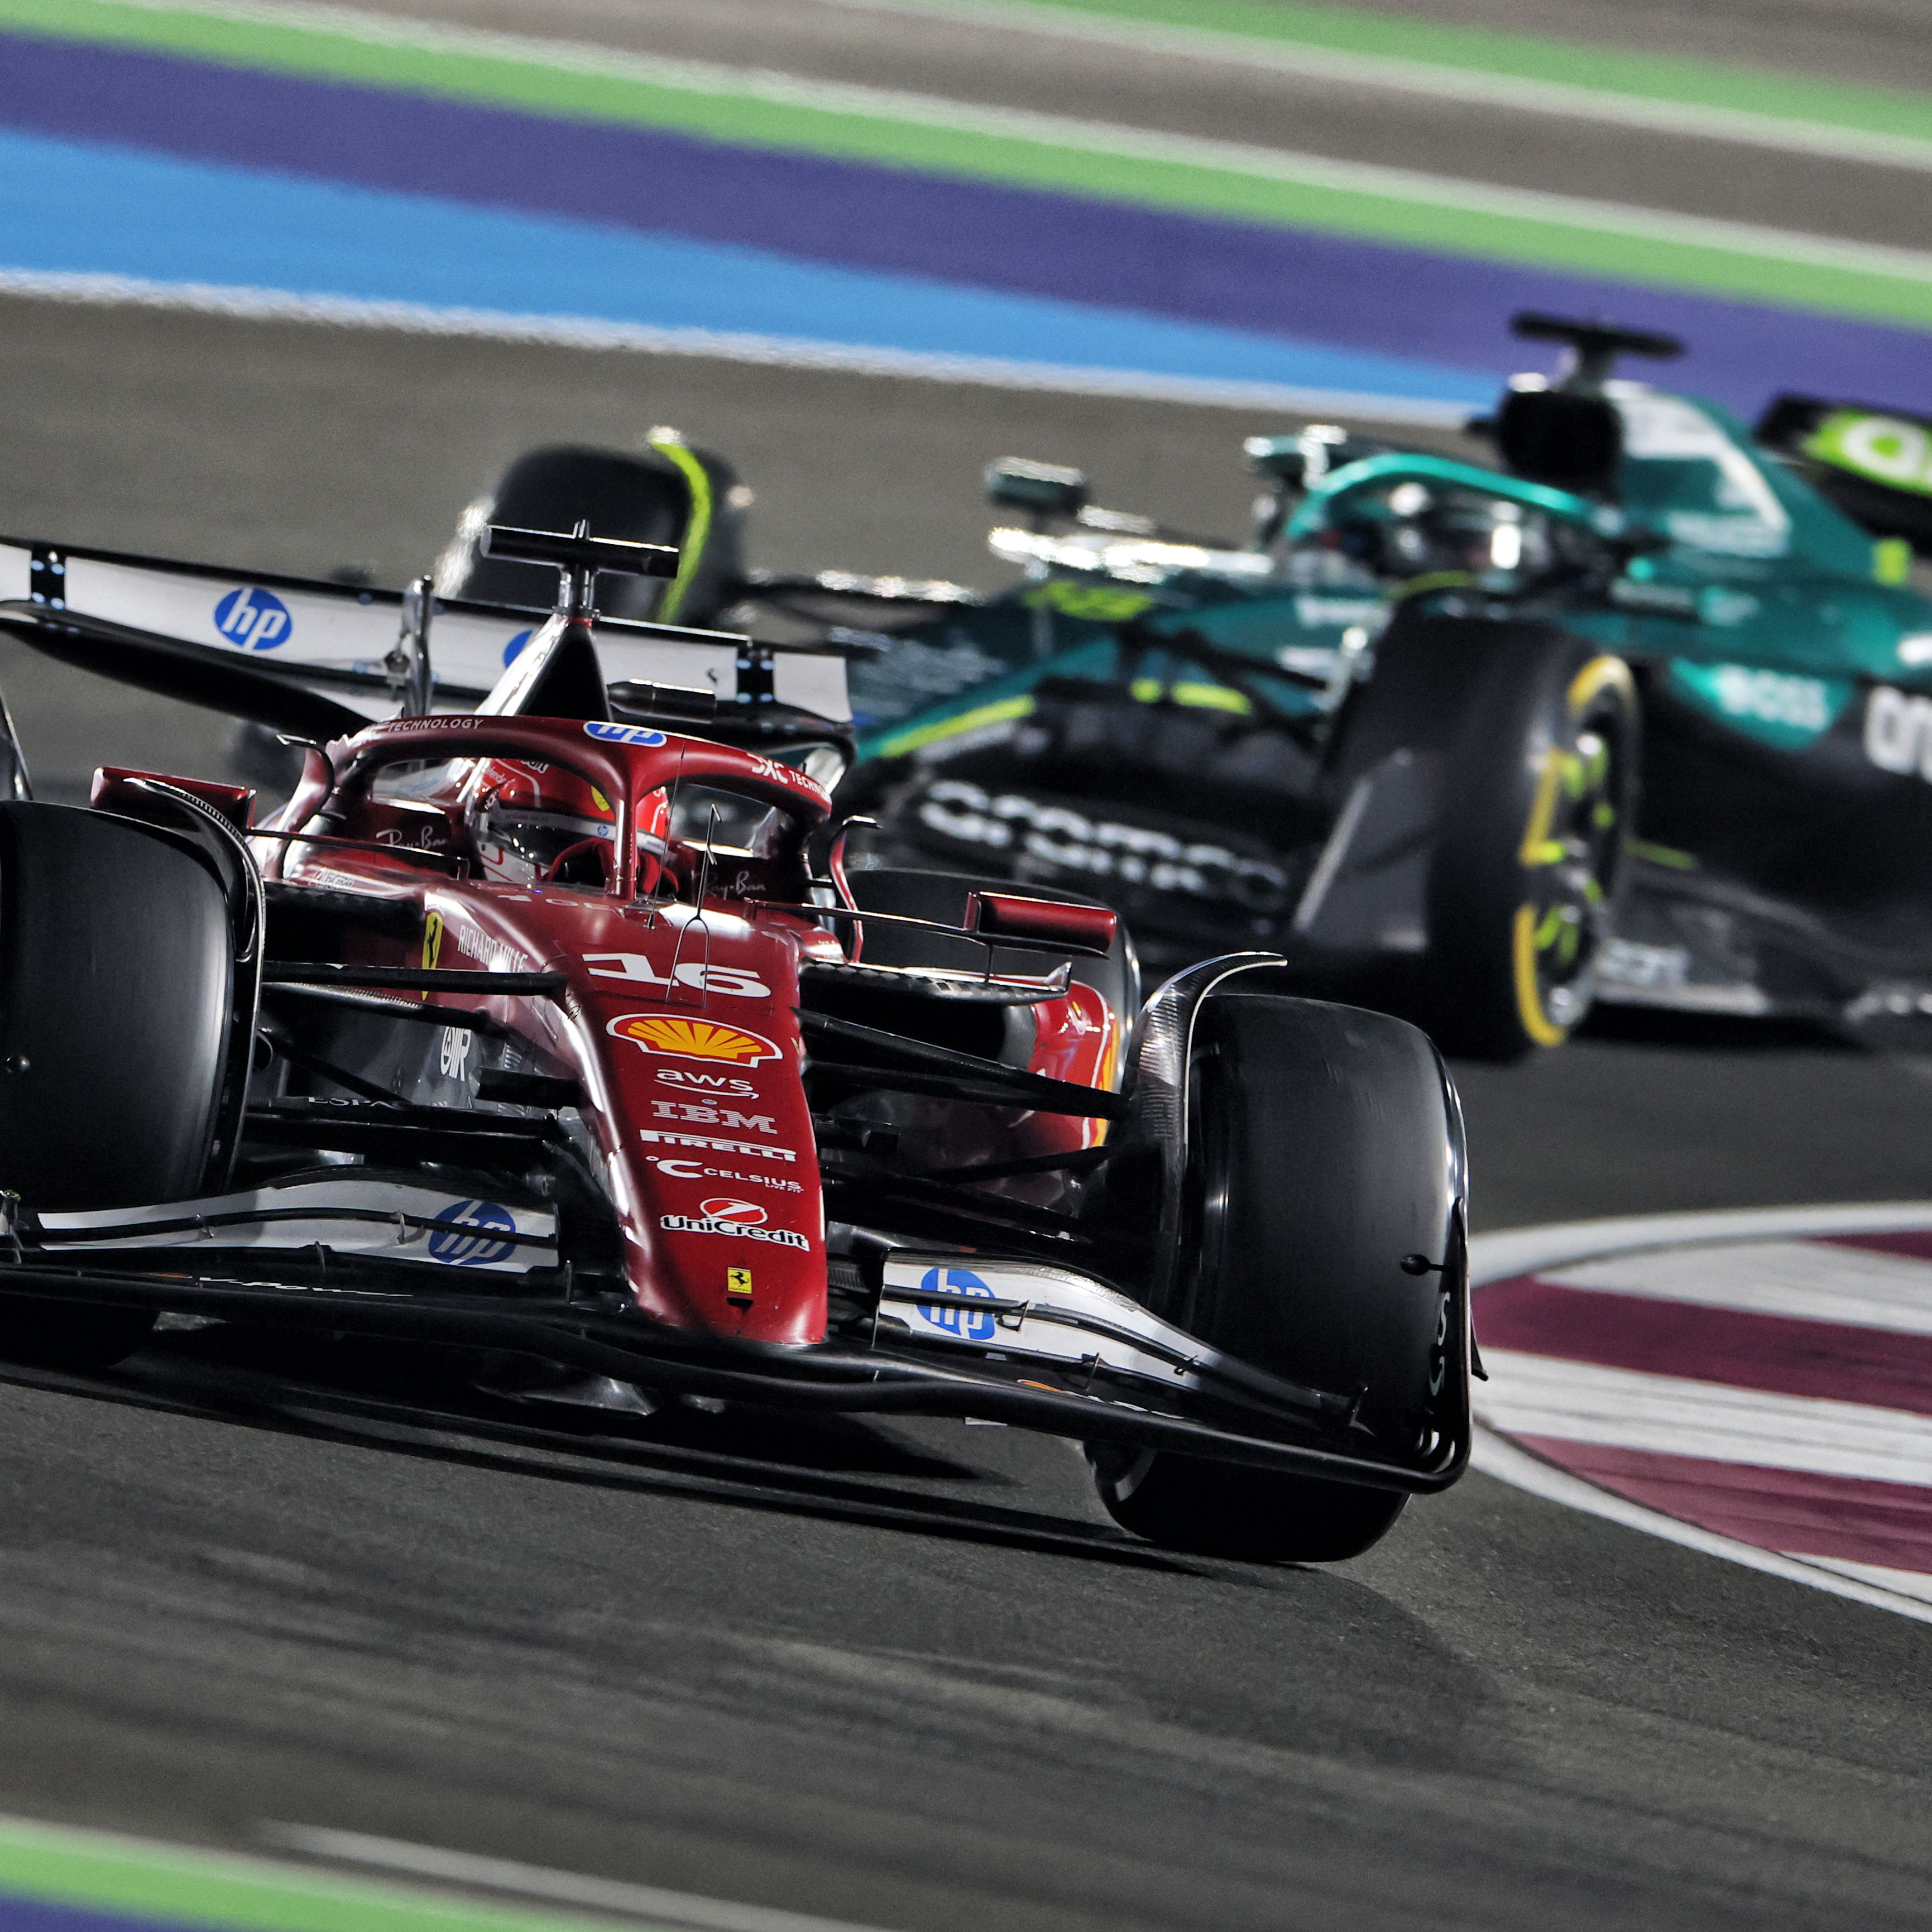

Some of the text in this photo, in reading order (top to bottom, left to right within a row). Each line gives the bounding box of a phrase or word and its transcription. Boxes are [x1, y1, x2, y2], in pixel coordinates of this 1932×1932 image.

[220, 587, 287, 650] hp
[388, 718, 483, 732] TECHNOLOGY
[746, 752, 788, 784] DXC
[457, 924, 497, 965] RICHARD
[582, 953, 771, 998] 16
[656, 1068, 754, 1092] aws
[651, 1100, 778, 1134] IBM
[640, 1129, 797, 1162] PIRELLI
[703, 1168, 802, 1190] CELSIUS
[433, 1200, 511, 1265] hp
[663, 1216, 807, 1249] UniCredit
[930, 1268, 990, 1339] hp
